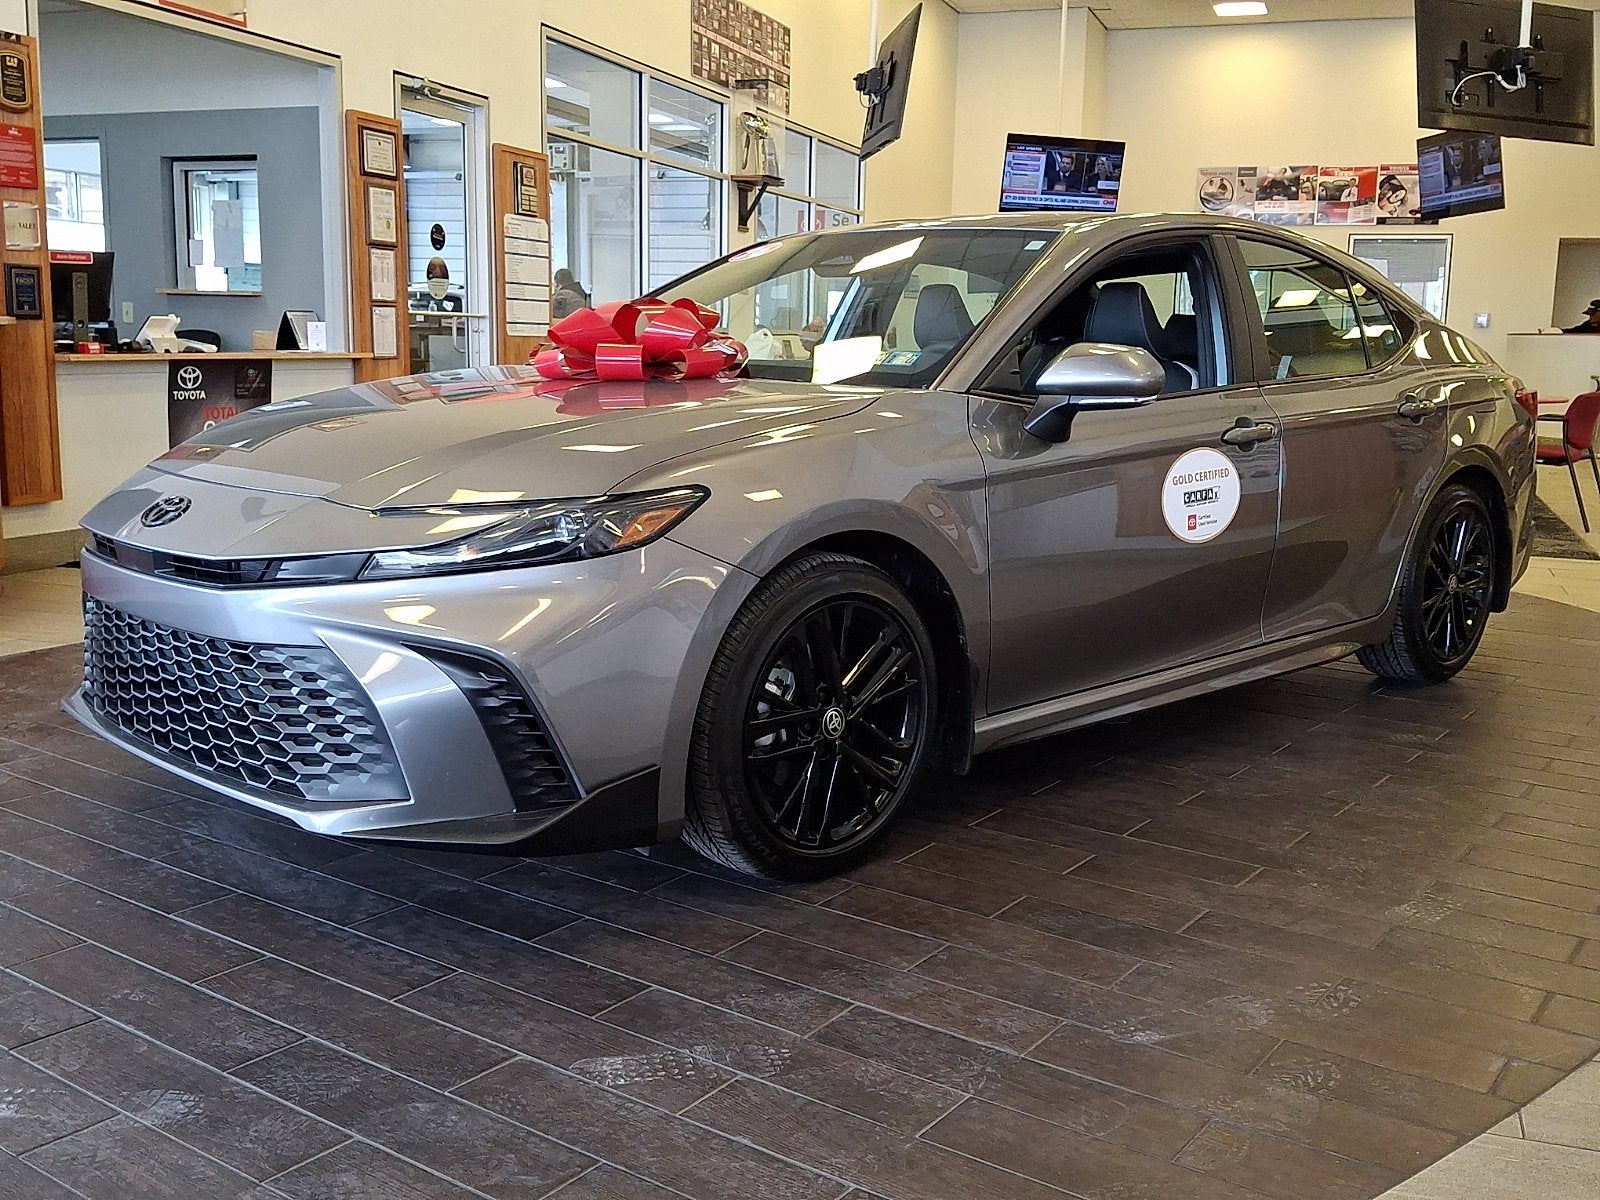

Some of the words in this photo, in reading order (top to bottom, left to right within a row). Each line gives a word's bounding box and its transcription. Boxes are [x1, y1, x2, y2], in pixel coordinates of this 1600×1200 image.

[172, 390, 206, 400] TOYOTA
[1172, 474, 1194, 486] GOLD
[1194, 468, 1230, 482] CERTIFIED
[1184, 486, 1220, 505] CARFAX
